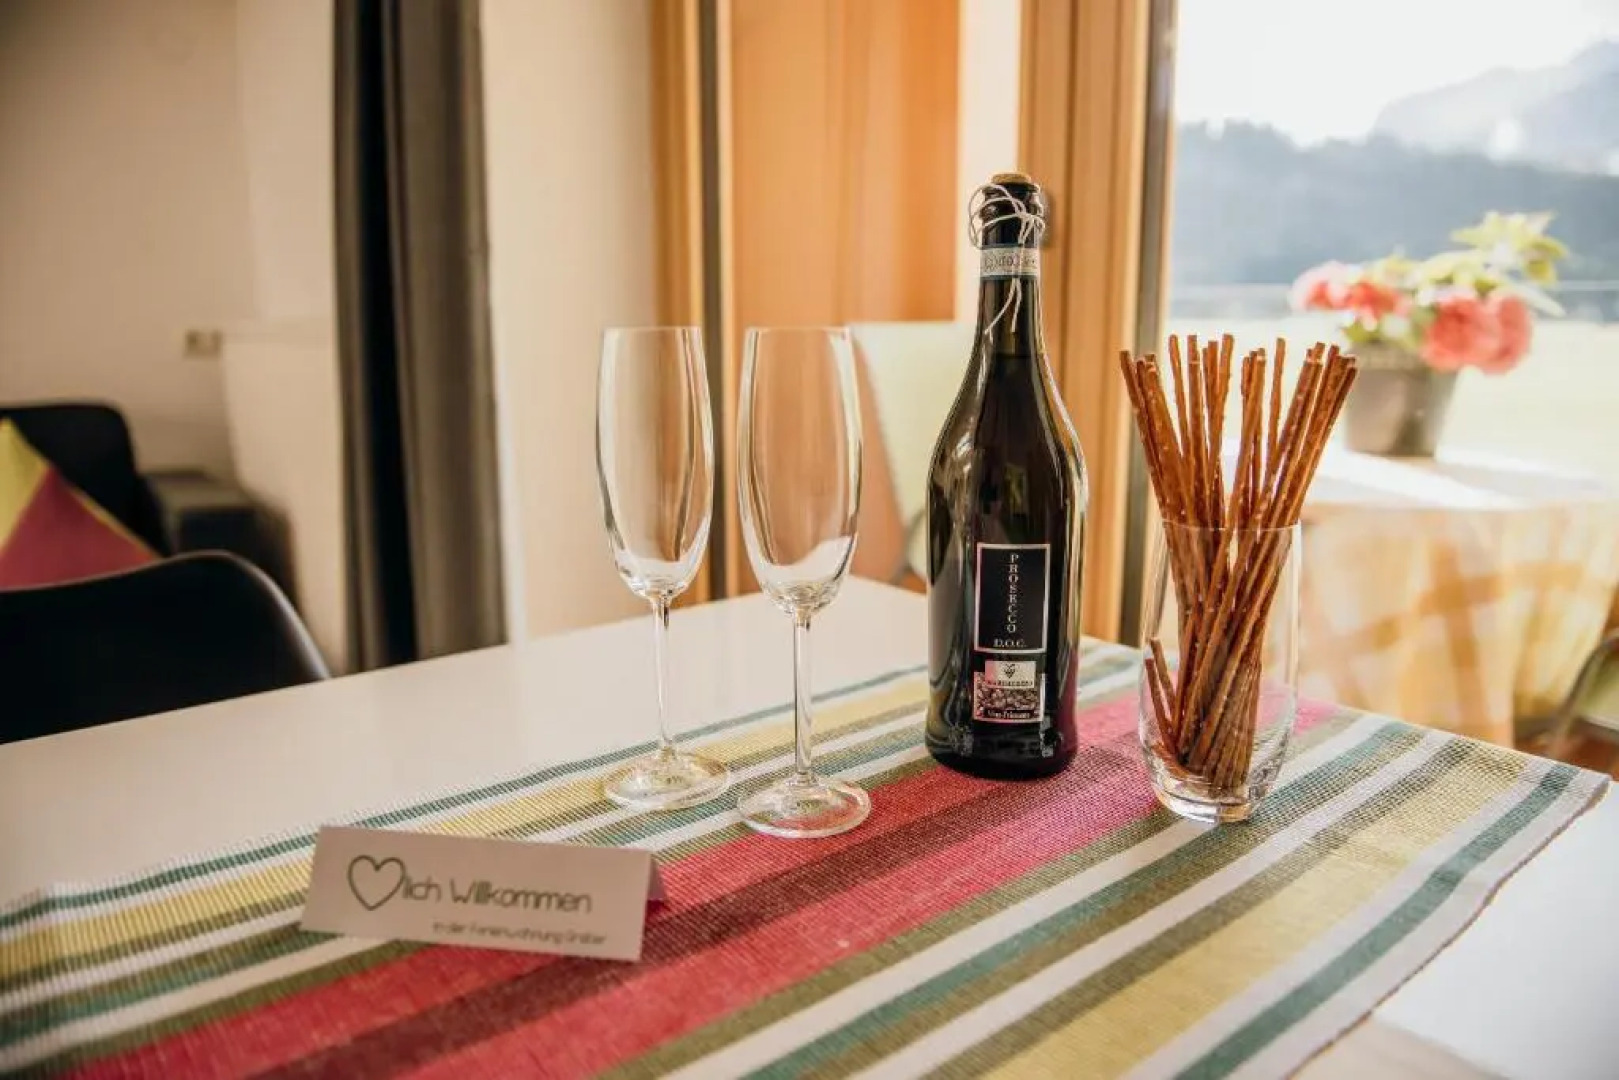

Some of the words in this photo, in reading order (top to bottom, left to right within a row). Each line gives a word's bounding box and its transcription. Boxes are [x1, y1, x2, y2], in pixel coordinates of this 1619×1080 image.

[1006, 553, 1019, 634] PROSECCO
[401, 874, 442, 903] lich
[449, 877, 592, 914] Willkommen
